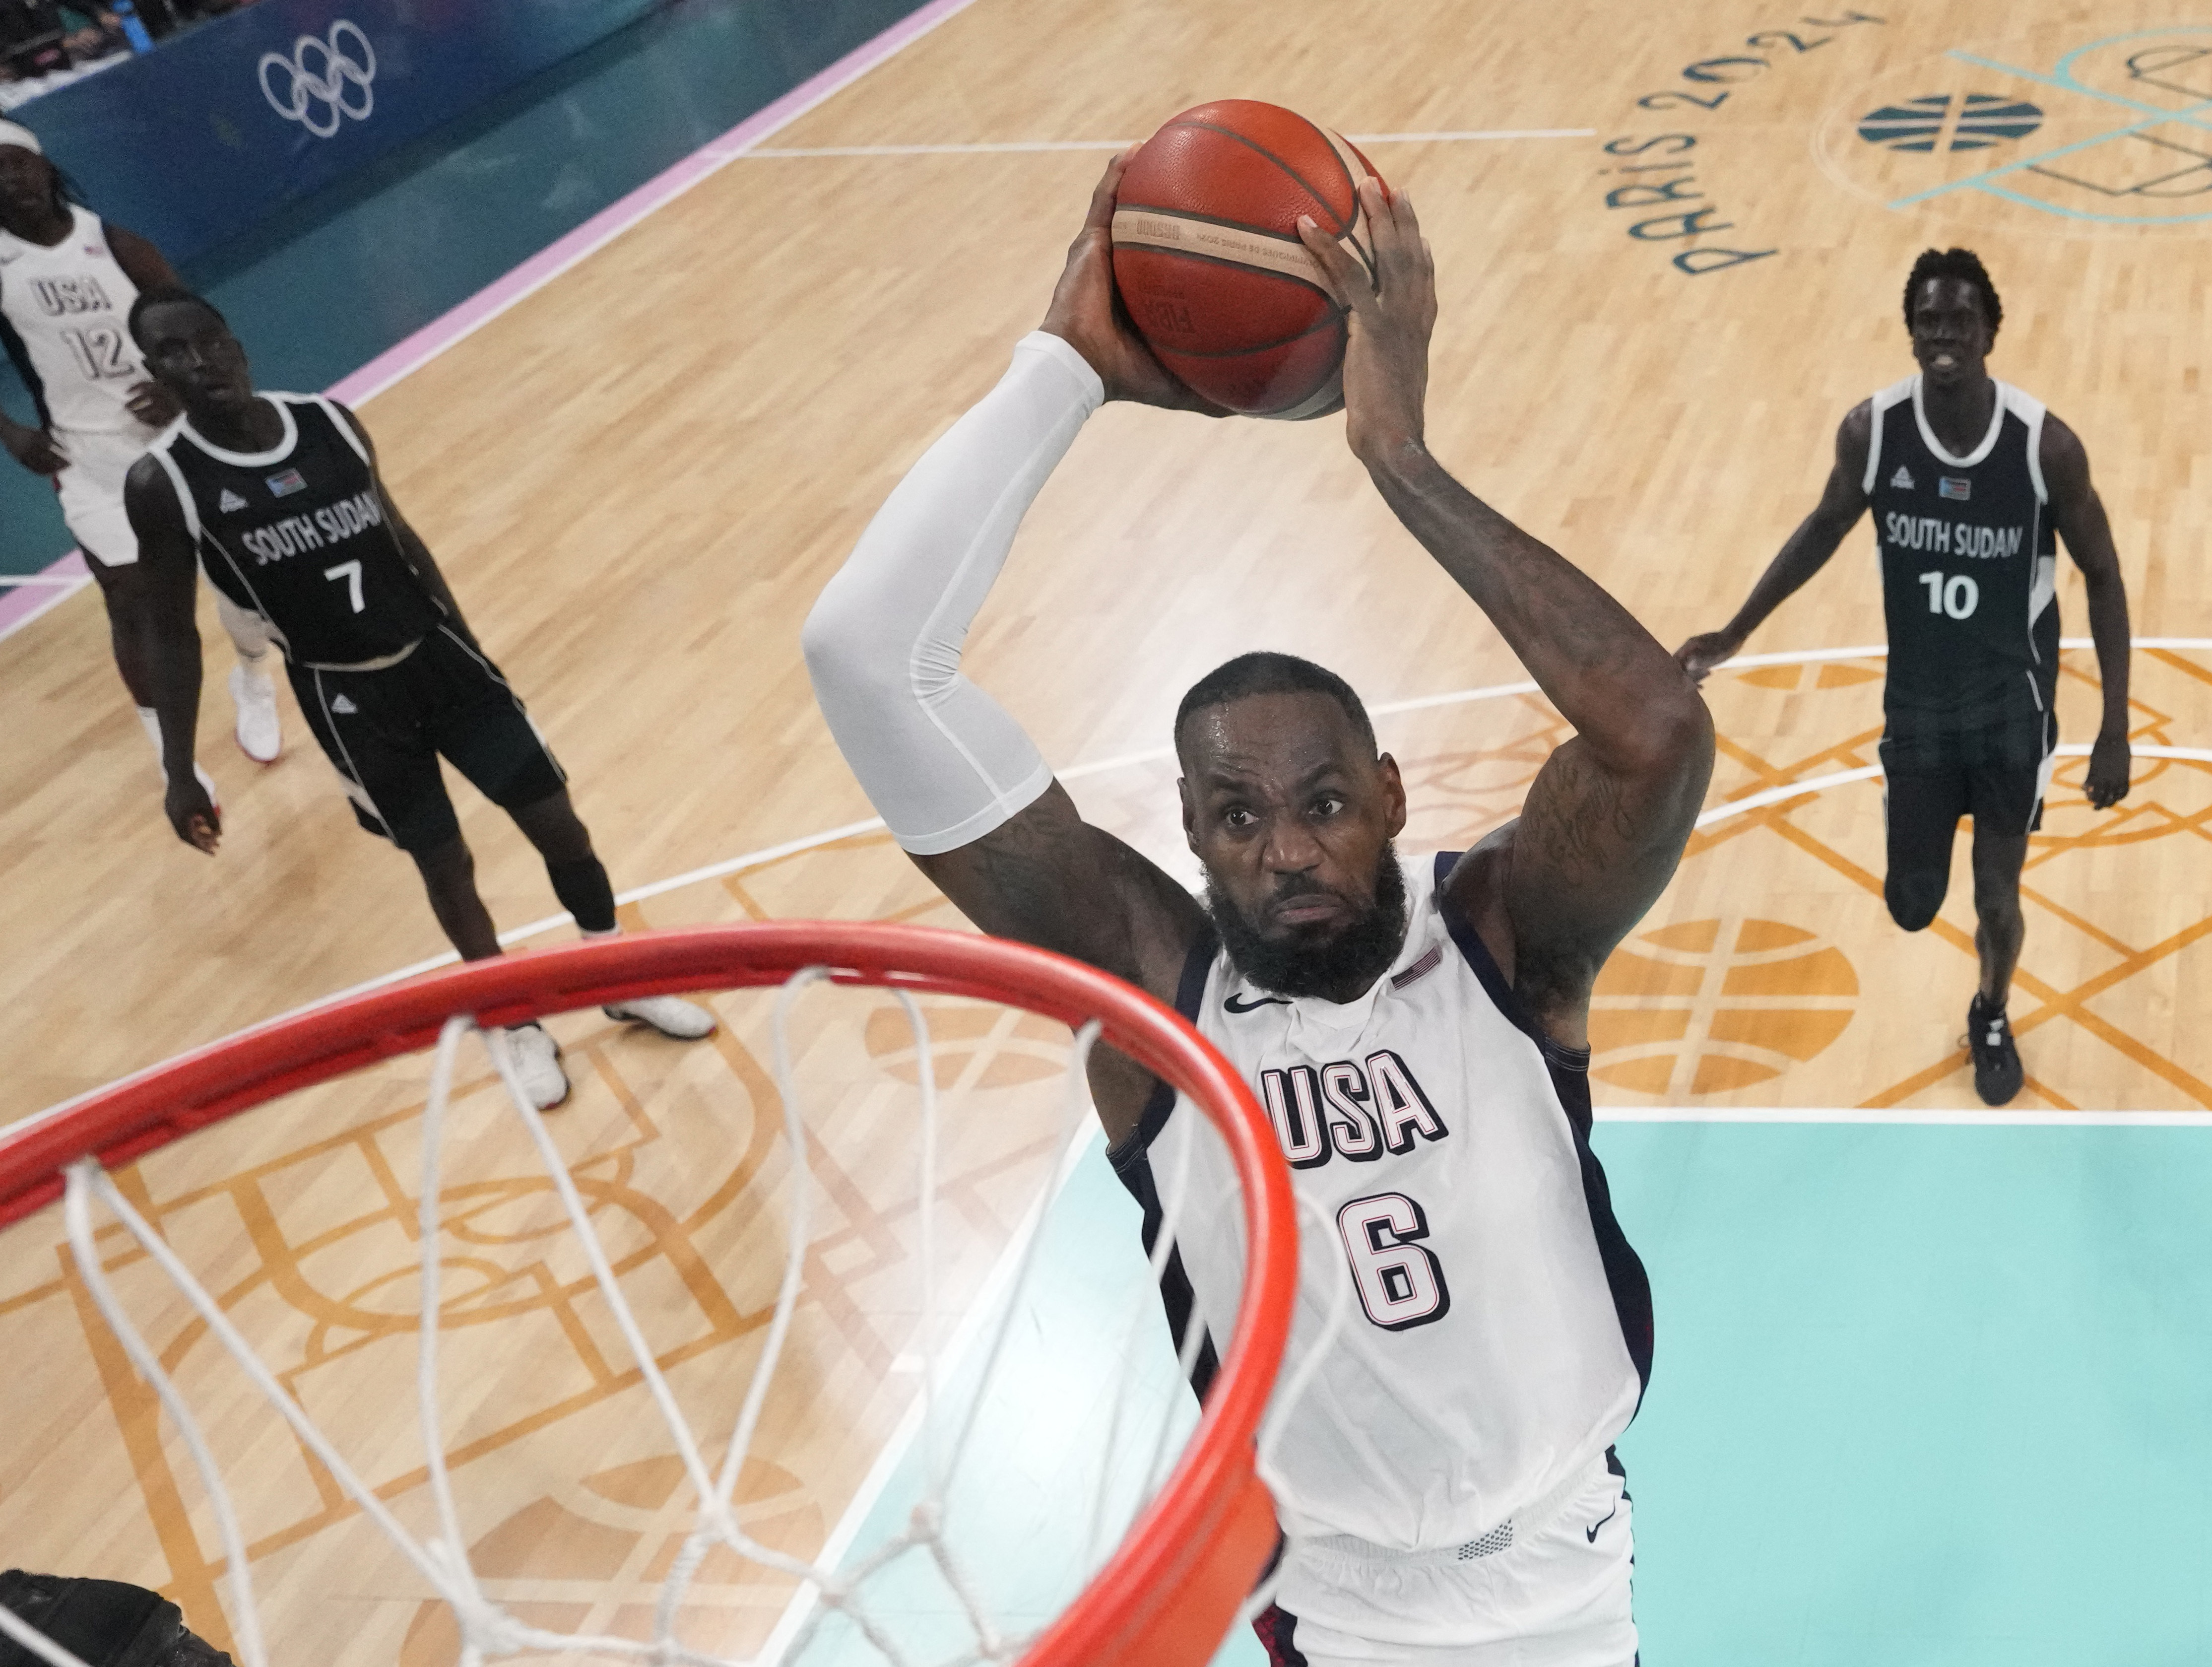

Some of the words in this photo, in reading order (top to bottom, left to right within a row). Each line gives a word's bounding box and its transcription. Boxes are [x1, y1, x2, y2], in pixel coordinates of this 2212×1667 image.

[1637, 9, 1887, 110] 2024
[27, 276, 112, 316] USA
[59, 324, 134, 380] 12
[242, 515, 324, 566] SOUTH
[1886, 511, 1951, 553] SOUTH
[1954, 523, 2023, 559] SUDAN
[323, 559, 367, 614] 7
[1919, 570, 1979, 620] 10
[1261, 1049, 1449, 1169] USA
[1336, 1192, 1450, 1331] 6
